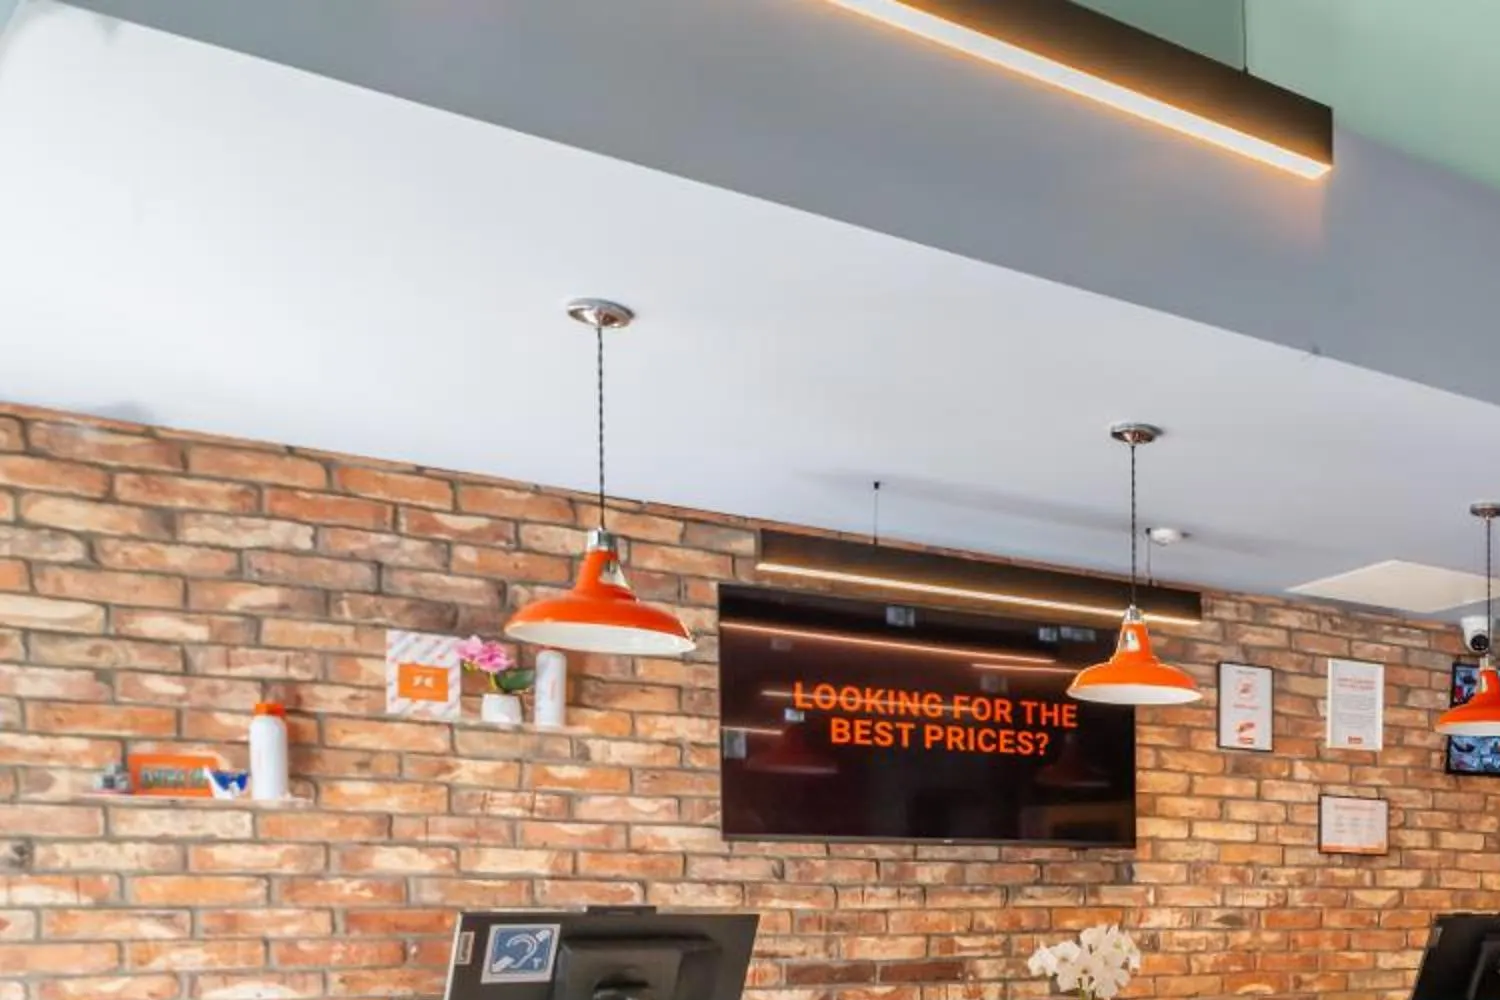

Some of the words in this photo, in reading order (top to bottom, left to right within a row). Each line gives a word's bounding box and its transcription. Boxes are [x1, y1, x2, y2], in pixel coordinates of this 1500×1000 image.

[793, 682, 943, 718] LOOKING
[953, 695, 1012, 724] FOR
[1020, 701, 1078, 728] THE
[831, 717, 915, 748] BEST
[924, 724, 1050, 757] PRICES?
